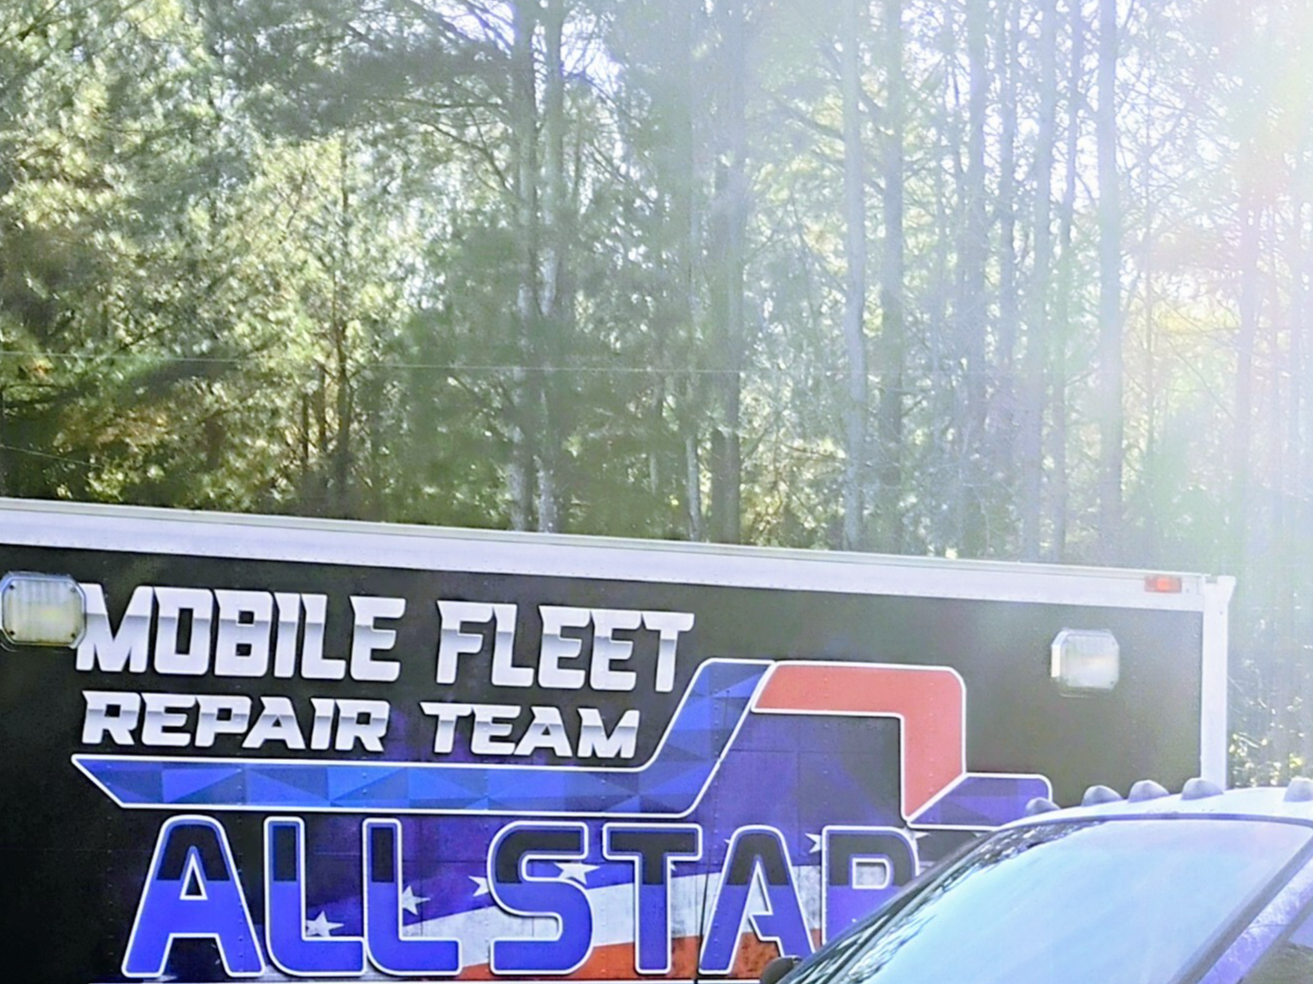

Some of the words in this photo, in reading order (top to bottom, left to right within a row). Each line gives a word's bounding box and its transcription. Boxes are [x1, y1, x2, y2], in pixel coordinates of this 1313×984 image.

[75, 583, 407, 682] MOBILE
[436, 600, 695, 692] FLEET
[81, 689, 390, 753] REPAIR
[419, 701, 640, 758] TEAM
